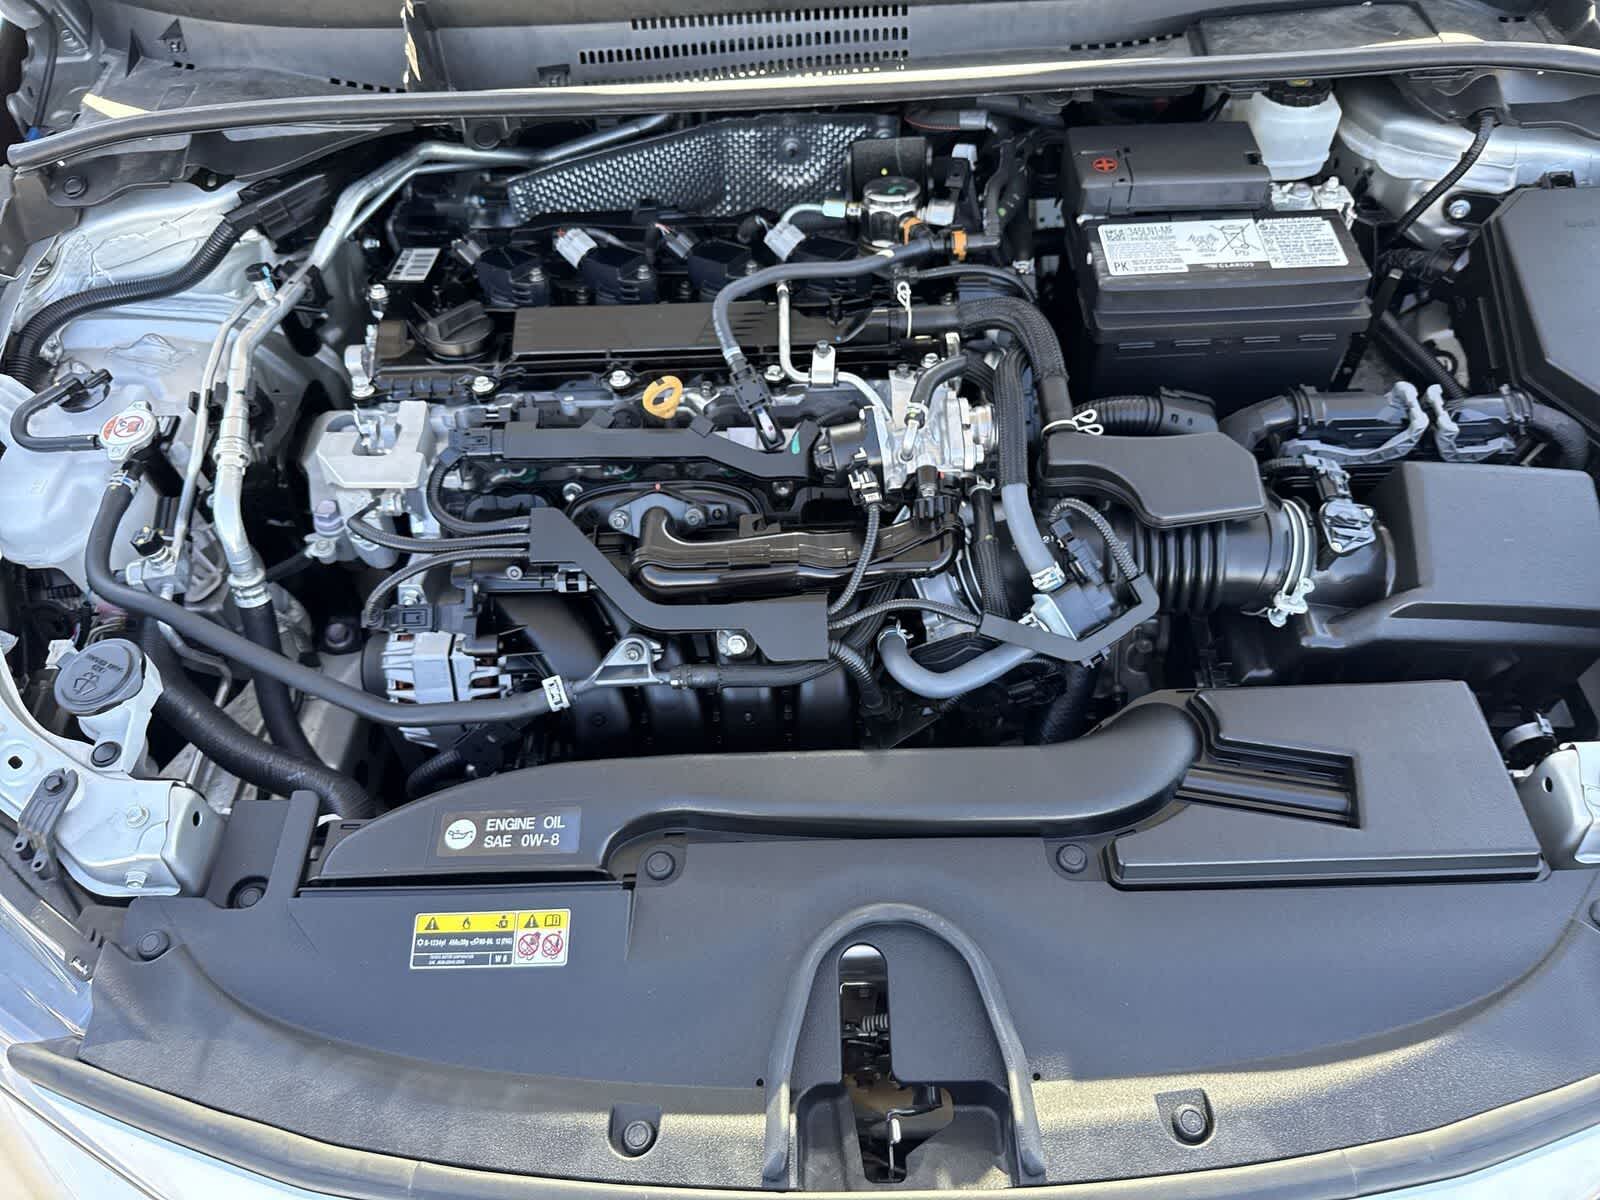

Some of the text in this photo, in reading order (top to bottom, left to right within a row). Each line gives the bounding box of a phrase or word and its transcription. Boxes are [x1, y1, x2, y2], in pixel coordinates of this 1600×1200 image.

[1113, 261, 1129, 272] PK
[486, 816, 566, 831] ENGINE OIL
[483, 833, 560, 848] SAE 0W-8
